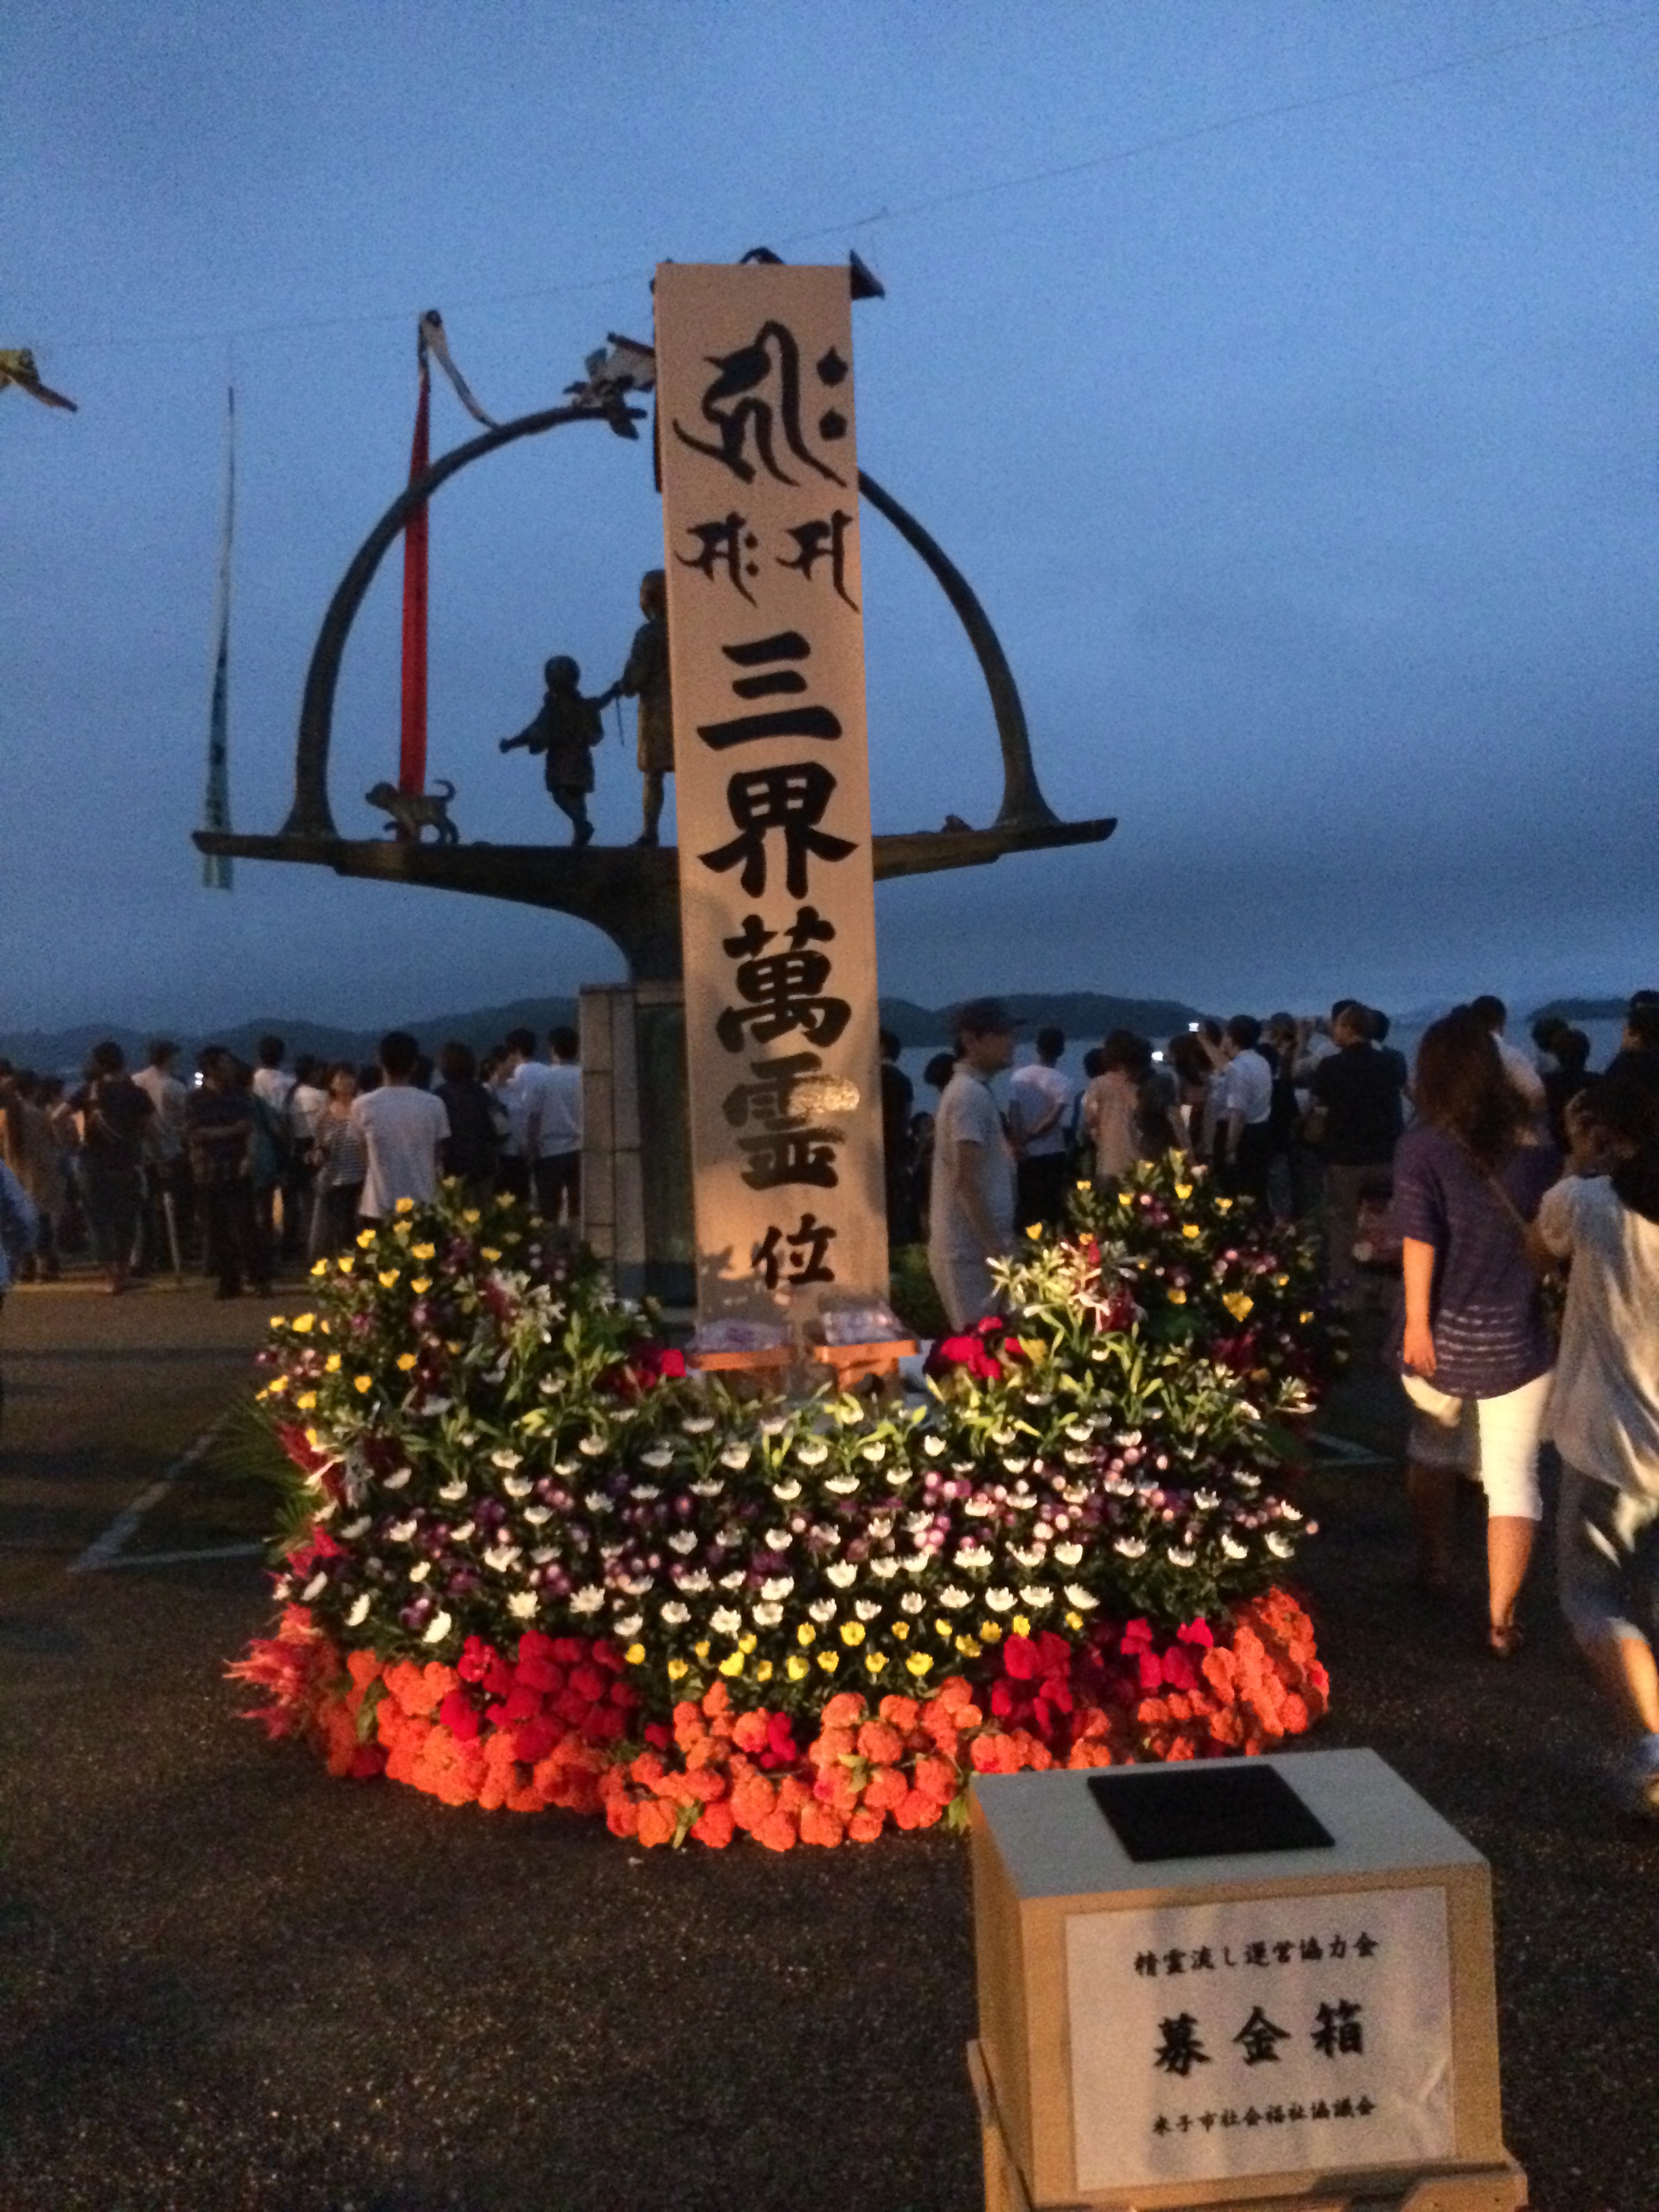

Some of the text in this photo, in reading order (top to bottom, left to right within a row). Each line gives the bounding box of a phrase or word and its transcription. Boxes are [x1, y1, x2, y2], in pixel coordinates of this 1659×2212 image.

[1153, 1999, 1364, 2077] 募金箱
[1153, 2095, 1376, 2137] 米子市社会福祉協議会
